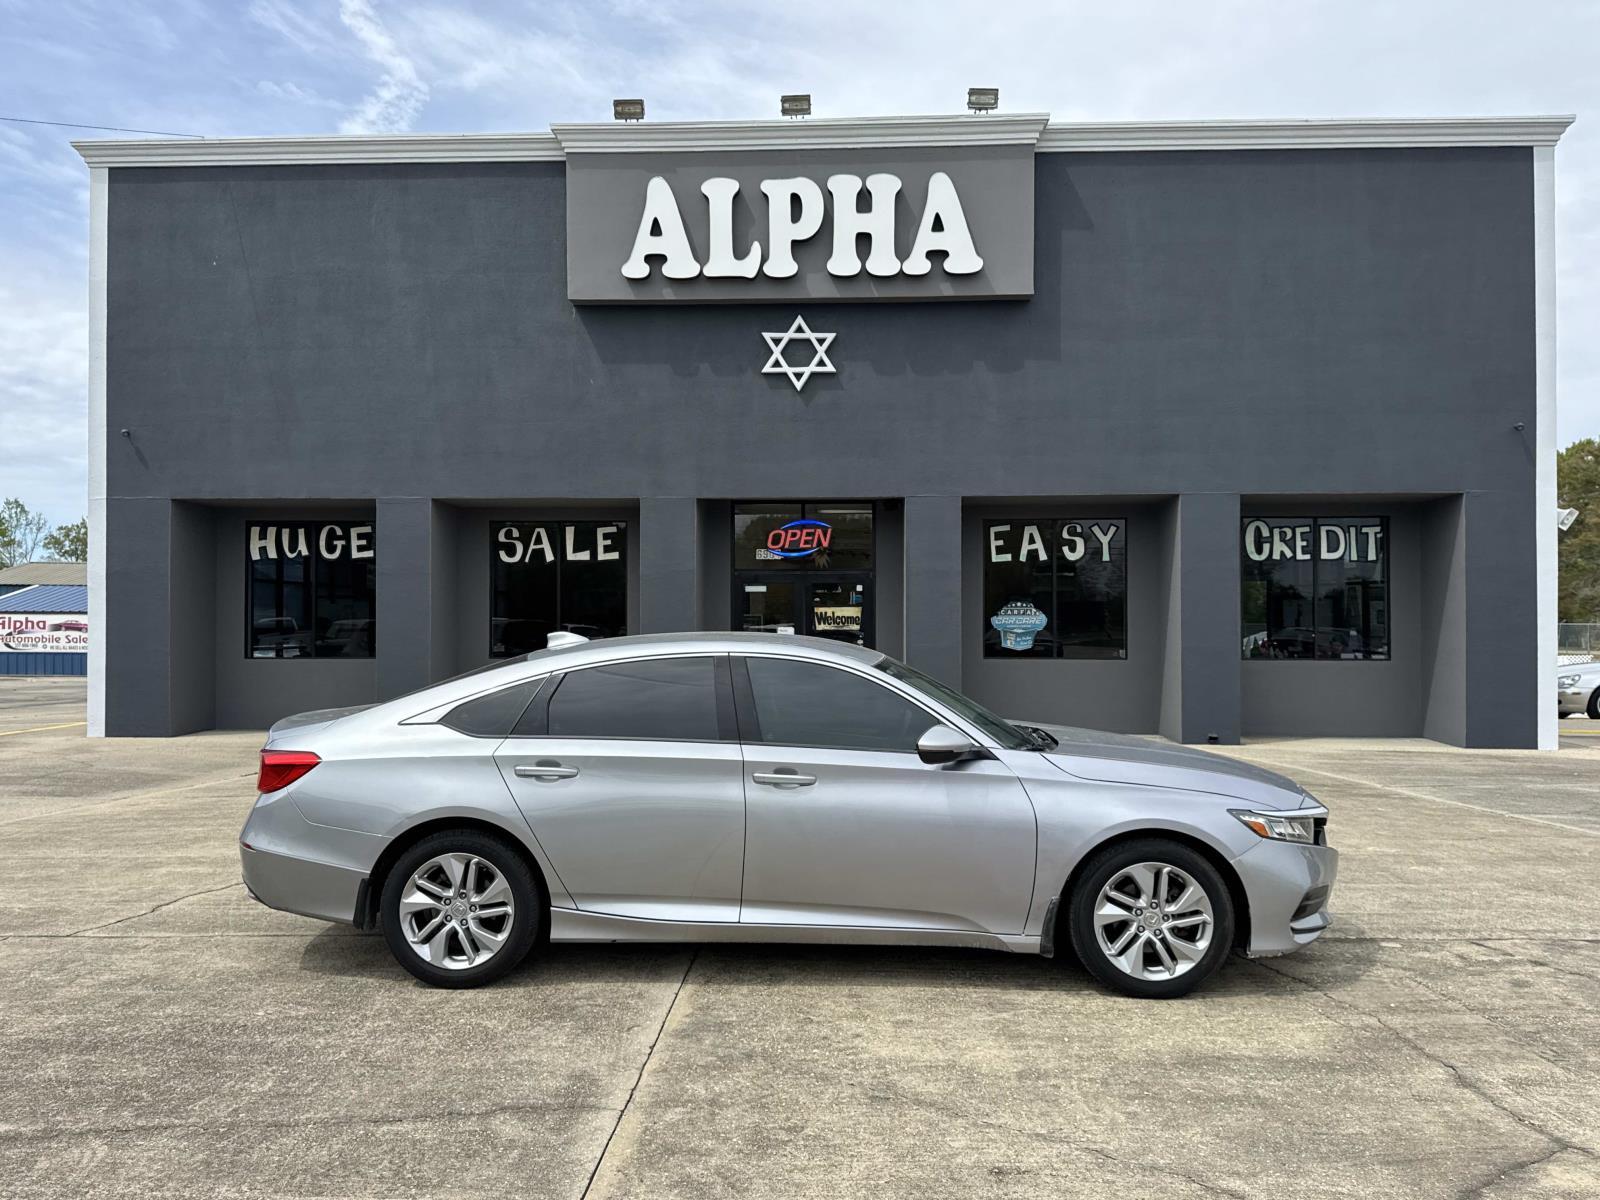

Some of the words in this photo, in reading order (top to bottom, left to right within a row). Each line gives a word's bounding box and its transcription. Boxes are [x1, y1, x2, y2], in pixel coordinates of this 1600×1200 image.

[620, 171, 984, 279] ALPHA
[249, 524, 375, 561] HUGE
[497, 526, 620, 563] SALE
[767, 528, 832, 549] OPEN
[989, 523, 1119, 563] EASY
[1244, 519, 1382, 562] CREDIT
[815, 611, 861, 625] Welcome
